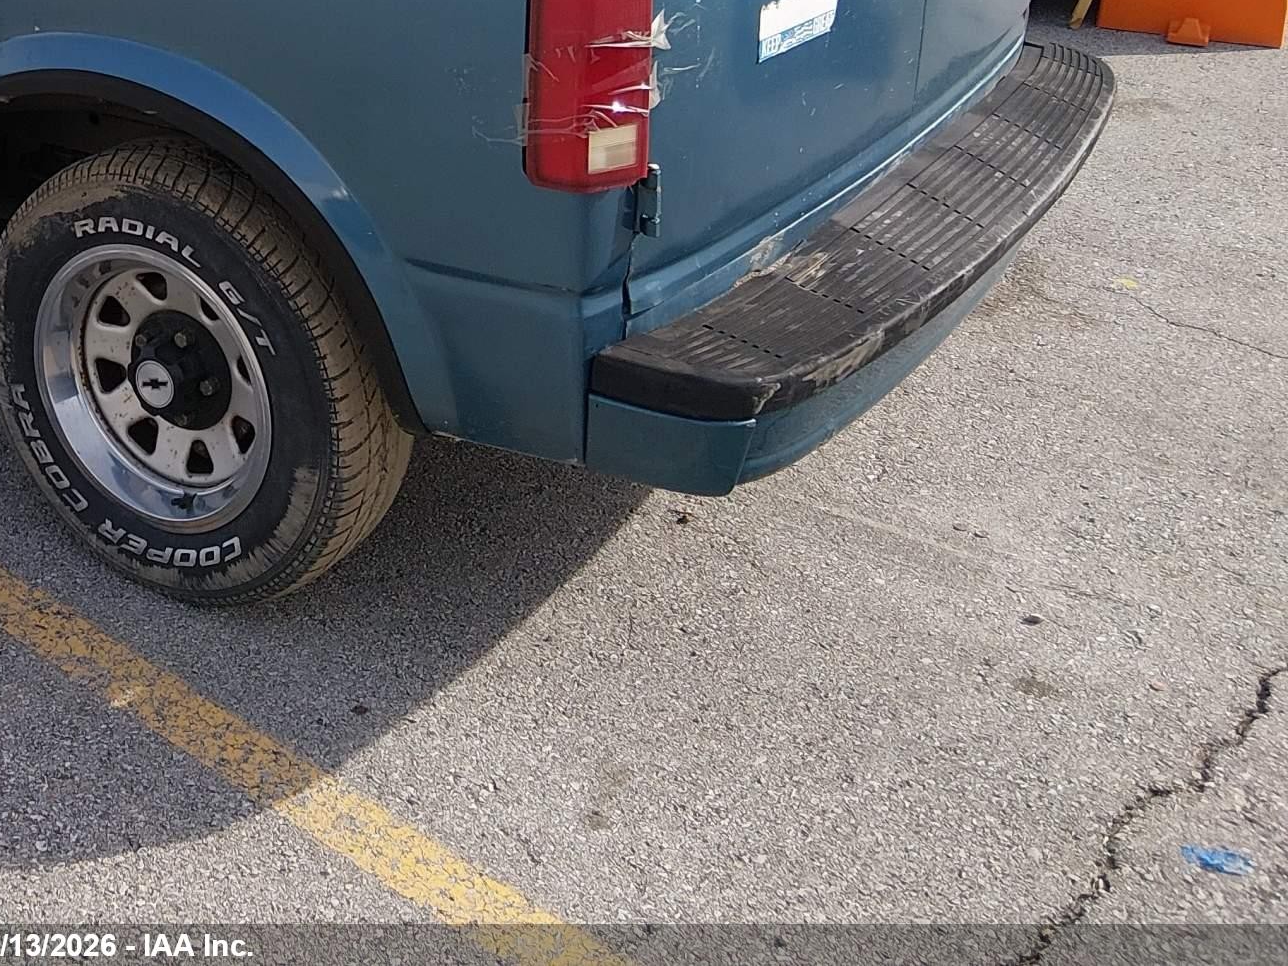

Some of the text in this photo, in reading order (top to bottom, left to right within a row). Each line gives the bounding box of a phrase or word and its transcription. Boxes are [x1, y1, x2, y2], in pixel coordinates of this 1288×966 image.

[73, 216, 276, 356] RADIAL G/T
[12, 385, 242, 567] COOPER COBRA
